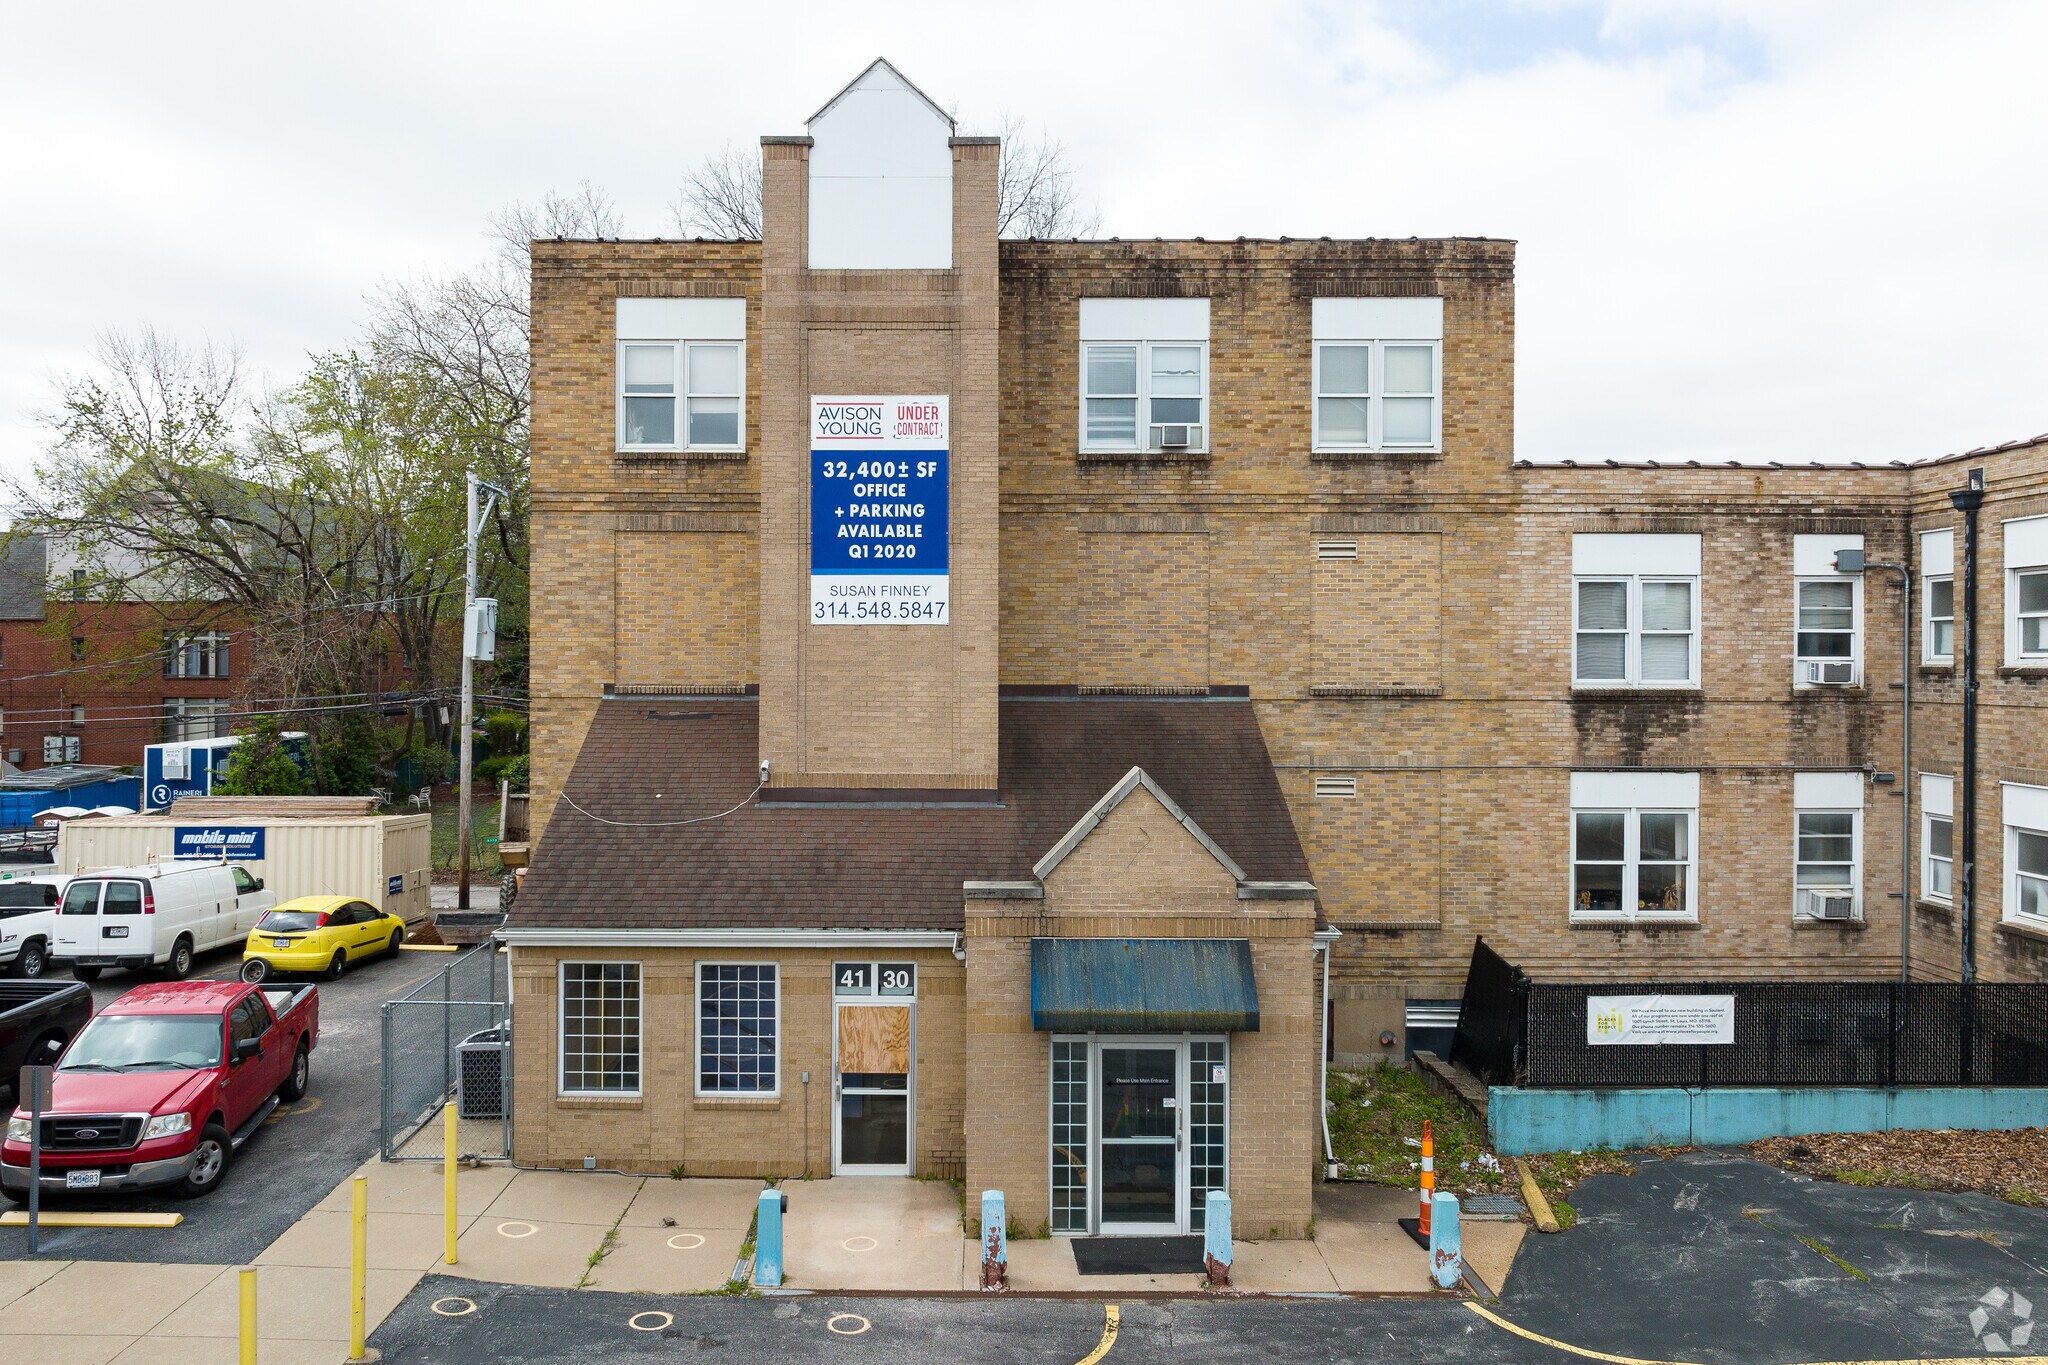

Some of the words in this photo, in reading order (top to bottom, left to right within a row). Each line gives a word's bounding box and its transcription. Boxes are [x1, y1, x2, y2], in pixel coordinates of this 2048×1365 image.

[818, 407, 881, 420] AVISON
[897, 405, 939, 420] UNDER
[818, 421, 882, 435] YOUNG
[897, 422, 939, 436] CONTRACT
[823, 461, 909, 480] 32,400±
[916, 461, 937, 478] SF
[853, 483, 906, 497] OFFICE
[834, 507, 844, 517] +
[850, 504, 925, 517] PARKING
[837, 524, 923, 538] AVAILABLE
[848, 545, 869, 559] Q1
[874, 545, 916, 559] 2020
[830, 585, 876, 597] SUSAN
[881, 585, 931, 597] FINNEY
[814, 601, 946, 619] 314.548.5847
[181, 830, 226, 844] mobile
[226, 832, 257, 844] mini
[840, 969, 864, 988] 41
[883, 970, 909, 989] 30
